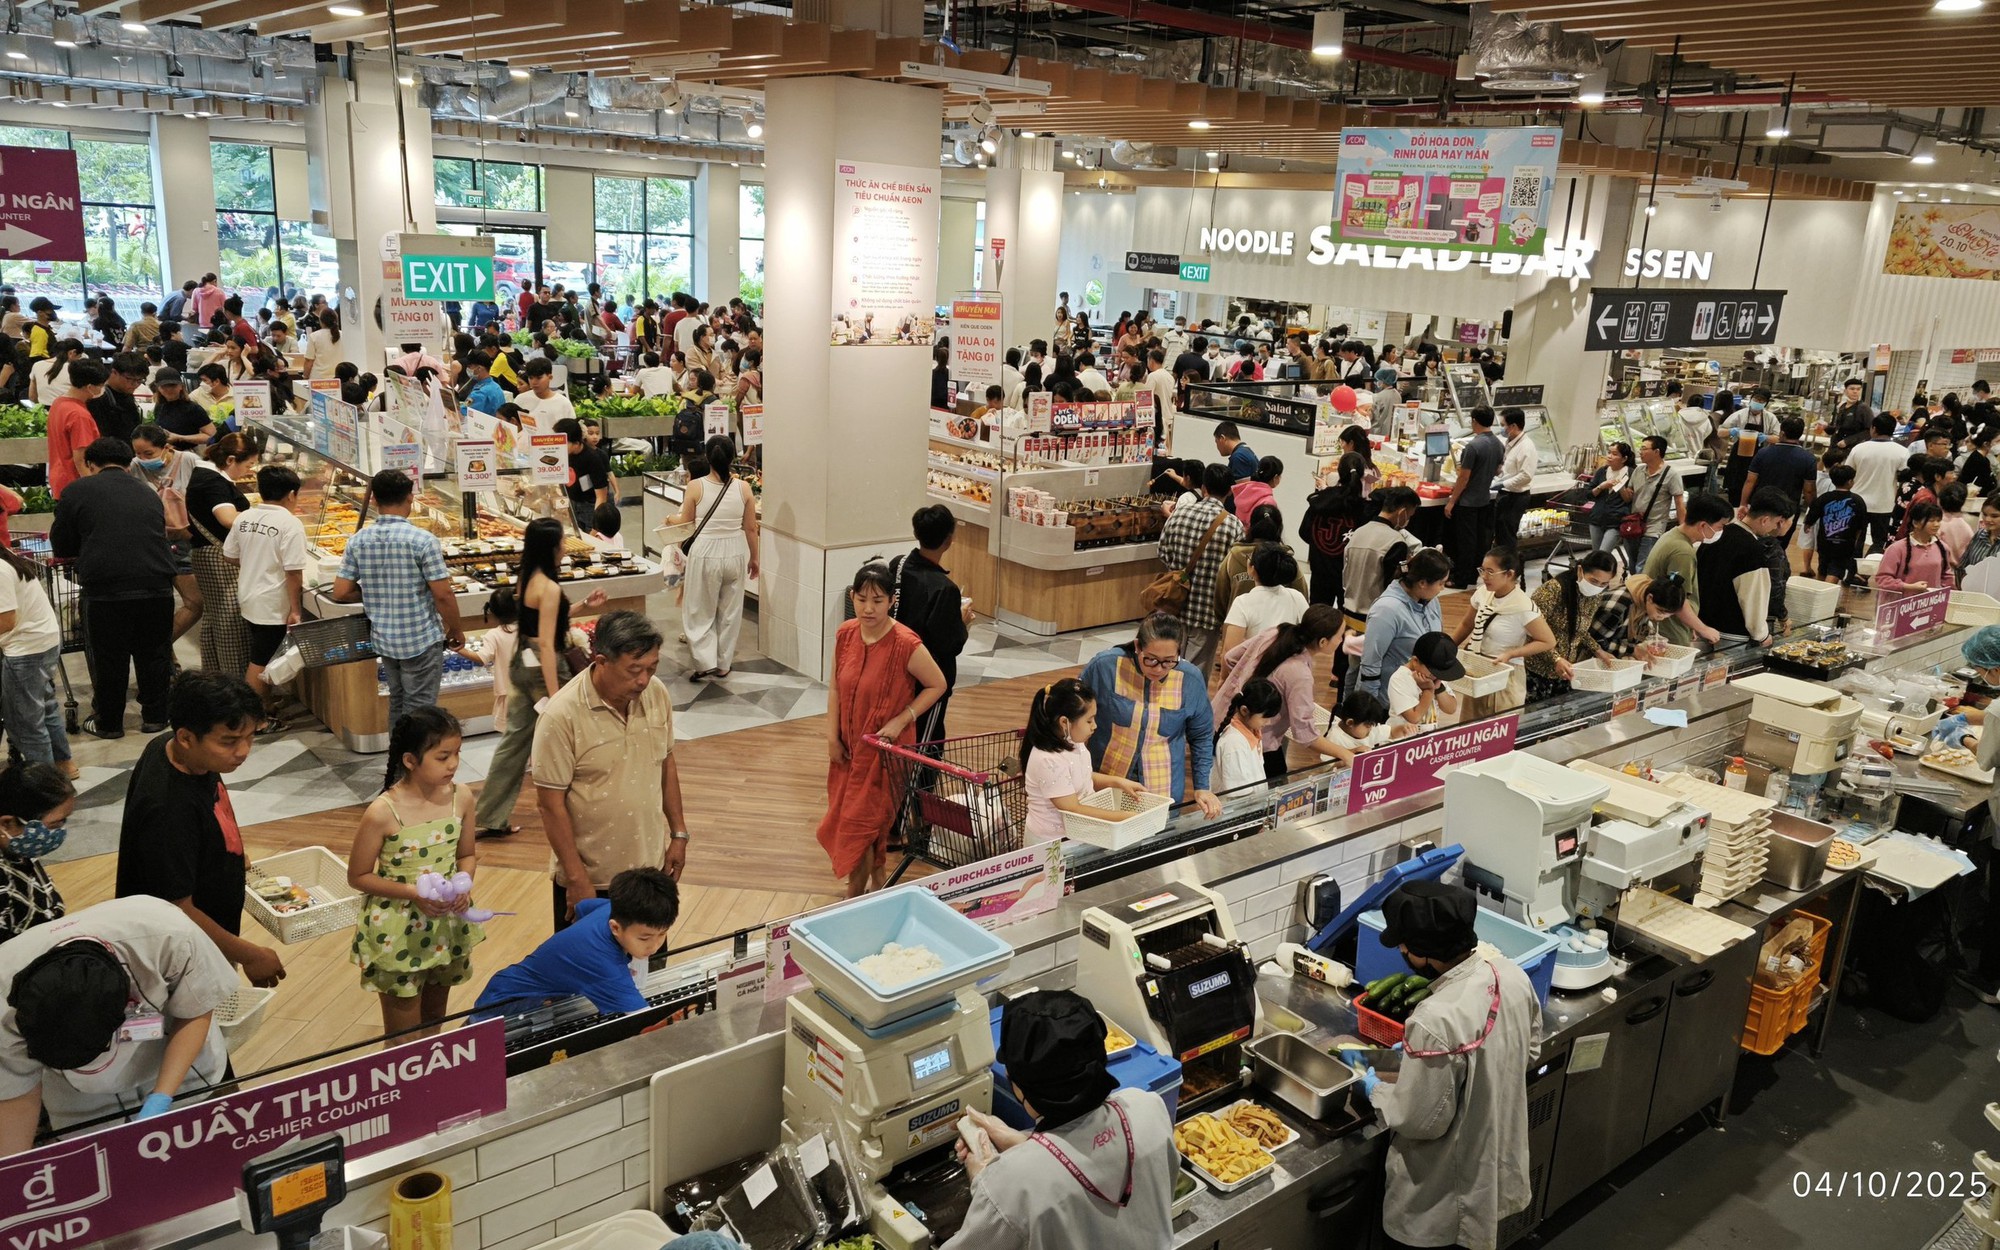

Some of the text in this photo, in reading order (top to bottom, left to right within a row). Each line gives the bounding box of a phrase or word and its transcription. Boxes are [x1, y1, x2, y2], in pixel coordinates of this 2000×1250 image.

[1411, 132, 1474, 147] ĐỔI HÓA ĐƠN
[1393, 147, 1489, 160] RINH QUÀ MAY MẮN
[845, 178, 867, 188] THỨC
[868, 179, 880, 189] ĂN
[881, 181, 896, 190] CHẾ
[898, 182, 915, 192] BIẾN
[12, 192, 74, 211] NGÂN
[468, 195, 482, 204] EXIT
[855, 190, 872, 200] TIÊU
[901, 195, 923, 204] AEON
[1200, 227, 1294, 255] NOODLE
[1940, 235, 1968, 253] 20.10
[1140, 254, 1156, 266] Quầy
[409, 261, 469, 293] EXIT
[1186, 265, 1208, 280] EXIT
[1653, 304, 1666, 312] ATM
[390, 311, 434, 324] TẶNG 01
[957, 336, 995, 347] MUA 04
[957, 348, 994, 362] TẶNG 01
[1264, 401, 1292, 415] Salad
[1053, 414, 1079, 425] ODEN
[1269, 414, 1287, 426] Bar
[1900, 591, 1947, 616] QUẦY THU NGÂN
[1405, 722, 1510, 766] QUẦY THU NGÂN
[1429, 745, 1482, 765] CASHIER COUNTER
[1364, 787, 1387, 803] VND
[948, 865, 1002, 886] PURCHASE
[1004, 854, 1034, 870] GUIDE
[736, 978, 756, 990] NIGIRI
[737, 987, 746, 997] CÁ
[747, 985, 759, 994] HỒI
[1191, 973, 1228, 996] SUZUMO
[138, 1039, 478, 1163] QUẦY THU NGÂN
[232, 1089, 402, 1151] CASHIER COUNTER
[910, 1101, 958, 1131] SUZUMO
[9, 1216, 91, 1250] VND
